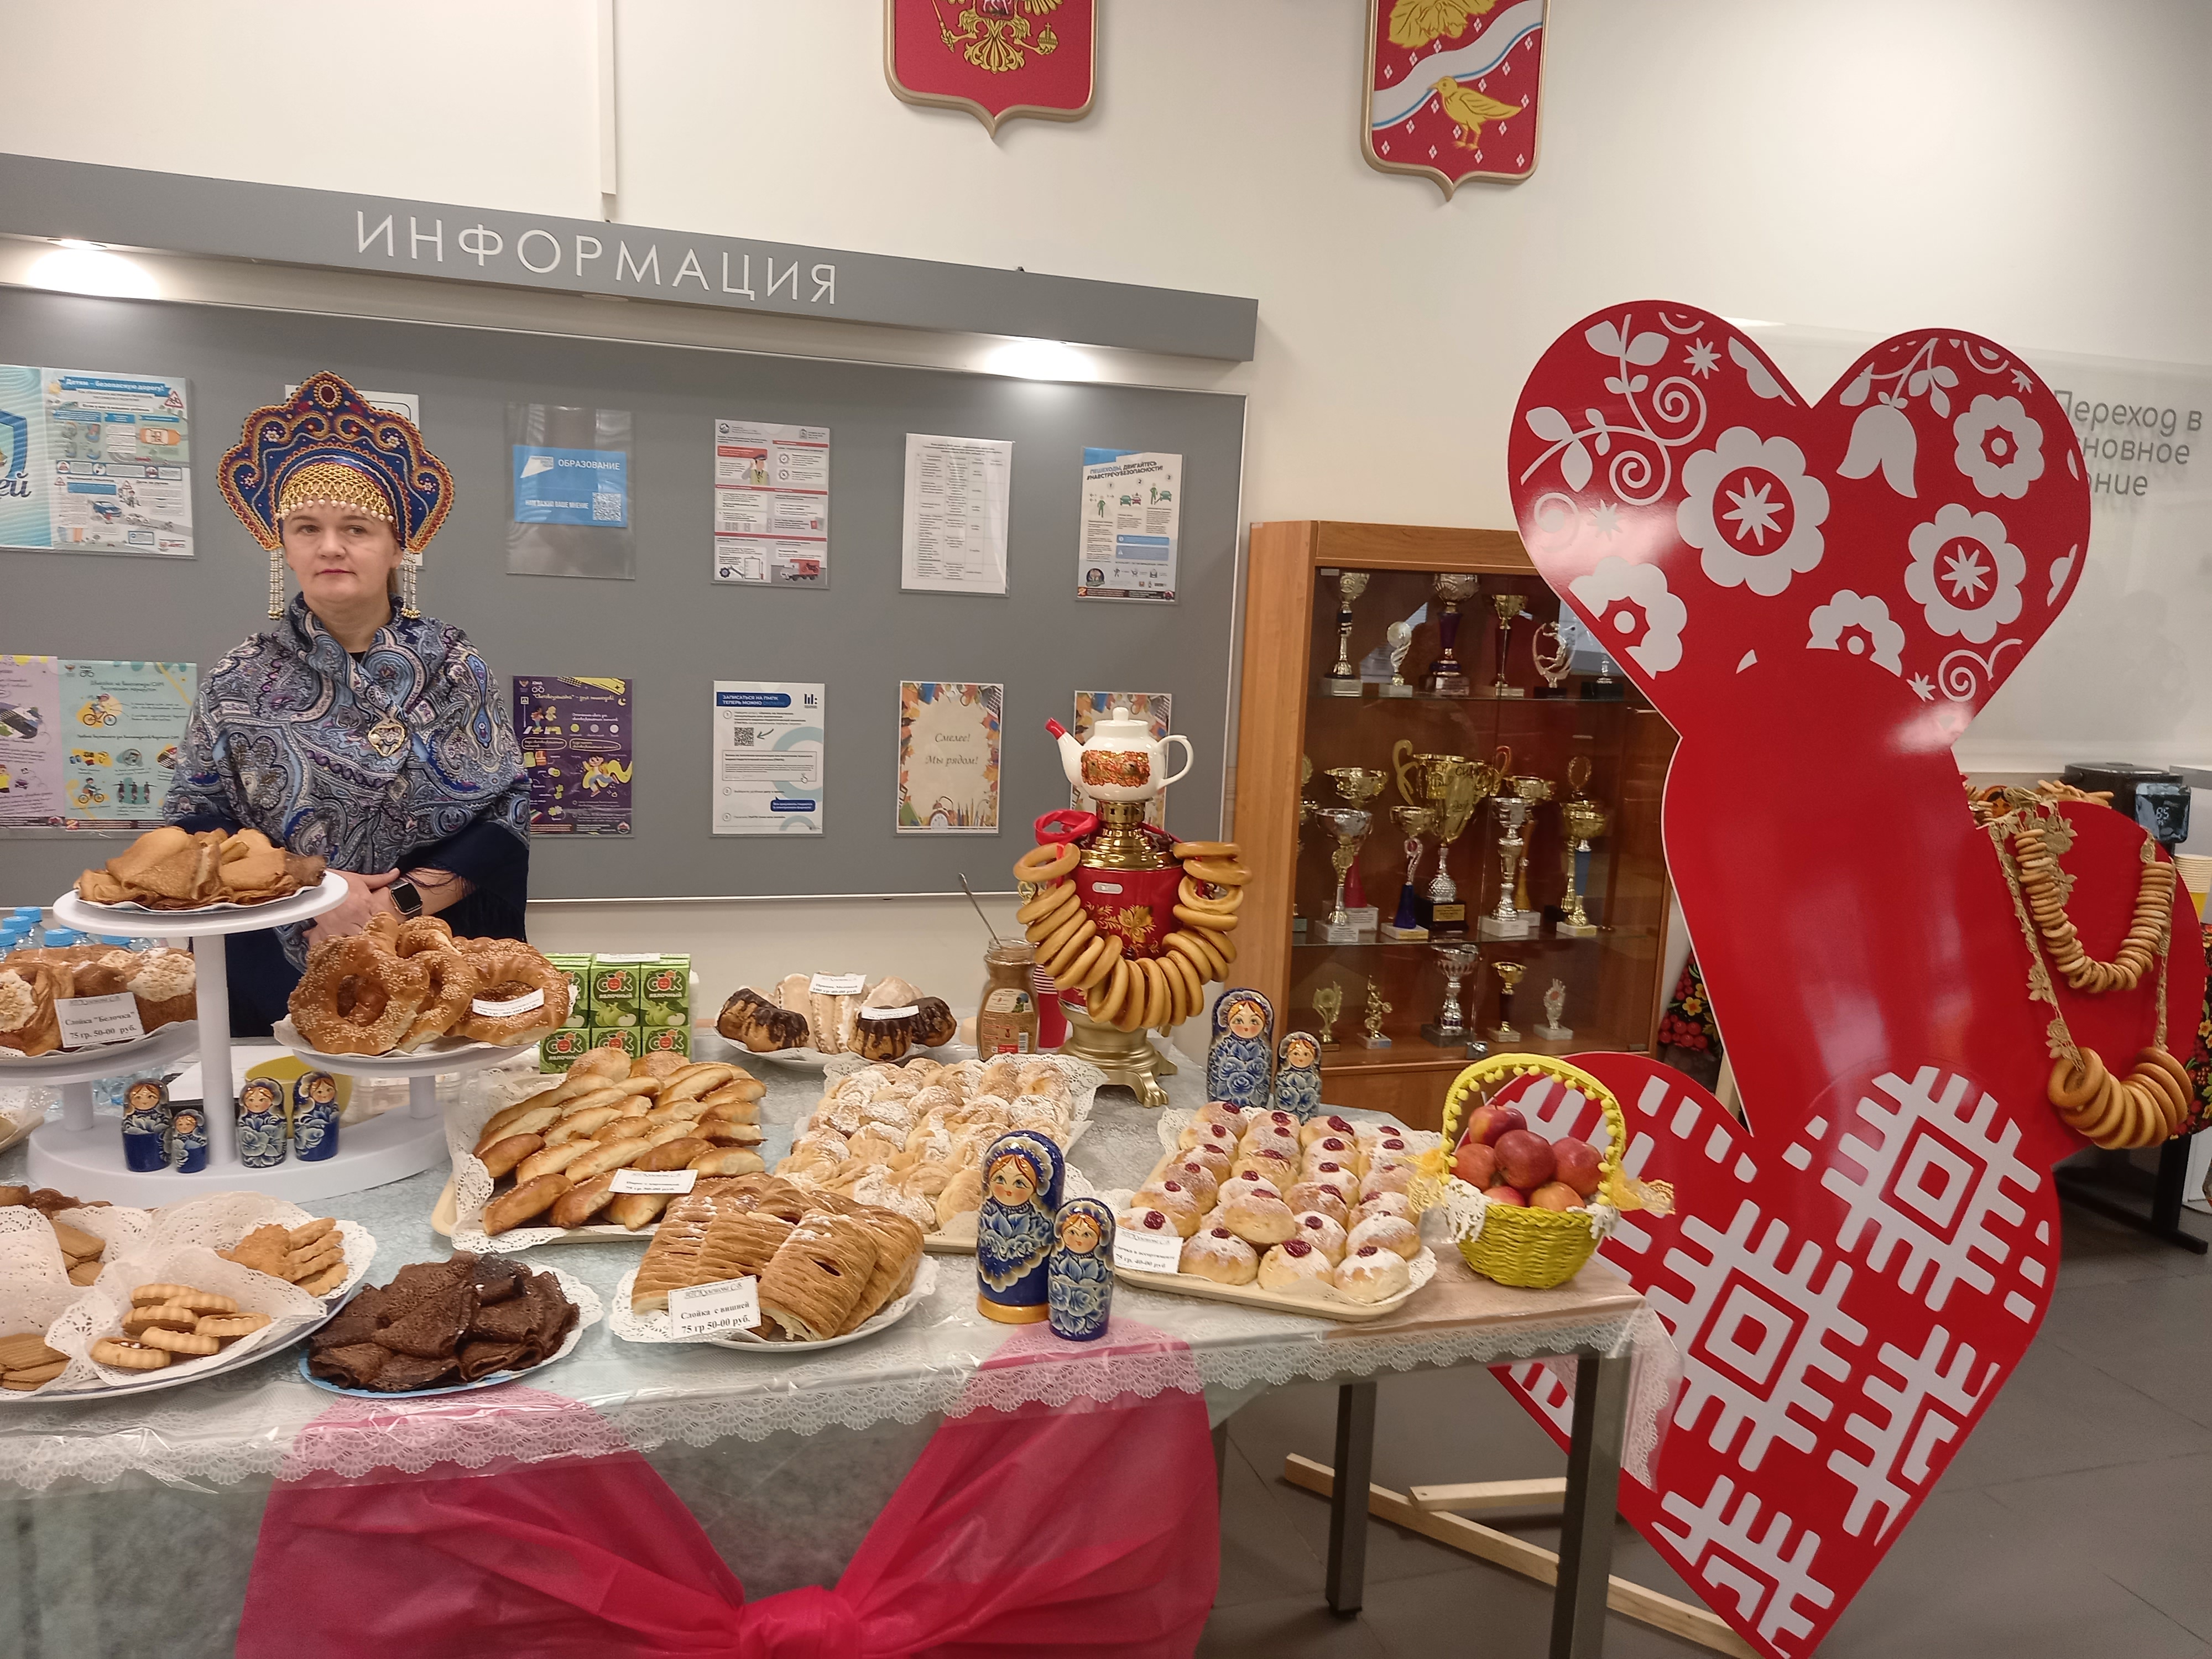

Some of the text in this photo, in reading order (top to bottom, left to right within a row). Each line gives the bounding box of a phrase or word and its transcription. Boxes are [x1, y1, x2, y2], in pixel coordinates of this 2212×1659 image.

[357, 211, 836, 304] ИНФОРМАЦИЯ
[2054, 390, 2202, 437] Переход в
[2077, 437, 2190, 465] новное
[558, 459, 620, 470] ОБРАЗОВАНИЕ
[1123, 461, 1157, 470] ДВИГАЙТЕСЬ
[2087, 473, 2147, 496] ние
[935, 733, 971, 743] Смелее!
[925, 755, 979, 767] Мы рядом!
[597, 977, 633, 992] СОК
[646, 976, 683, 992] СОК
[94, 1011, 134, 1022] "Белочка"
[93, 1028, 115, 1036] 50-00
[119, 1025, 137, 1034] руб.
[546, 1038, 583, 1054] СОК
[649, 1035, 685, 1051] СОК
[681, 1310, 711, 1319] Слойка
[721, 1302, 750, 1313] вишней
[682, 1325, 692, 1333] 75
[707, 1318, 730, 1329] 50-00
[732, 1315, 750, 1326] руб.
